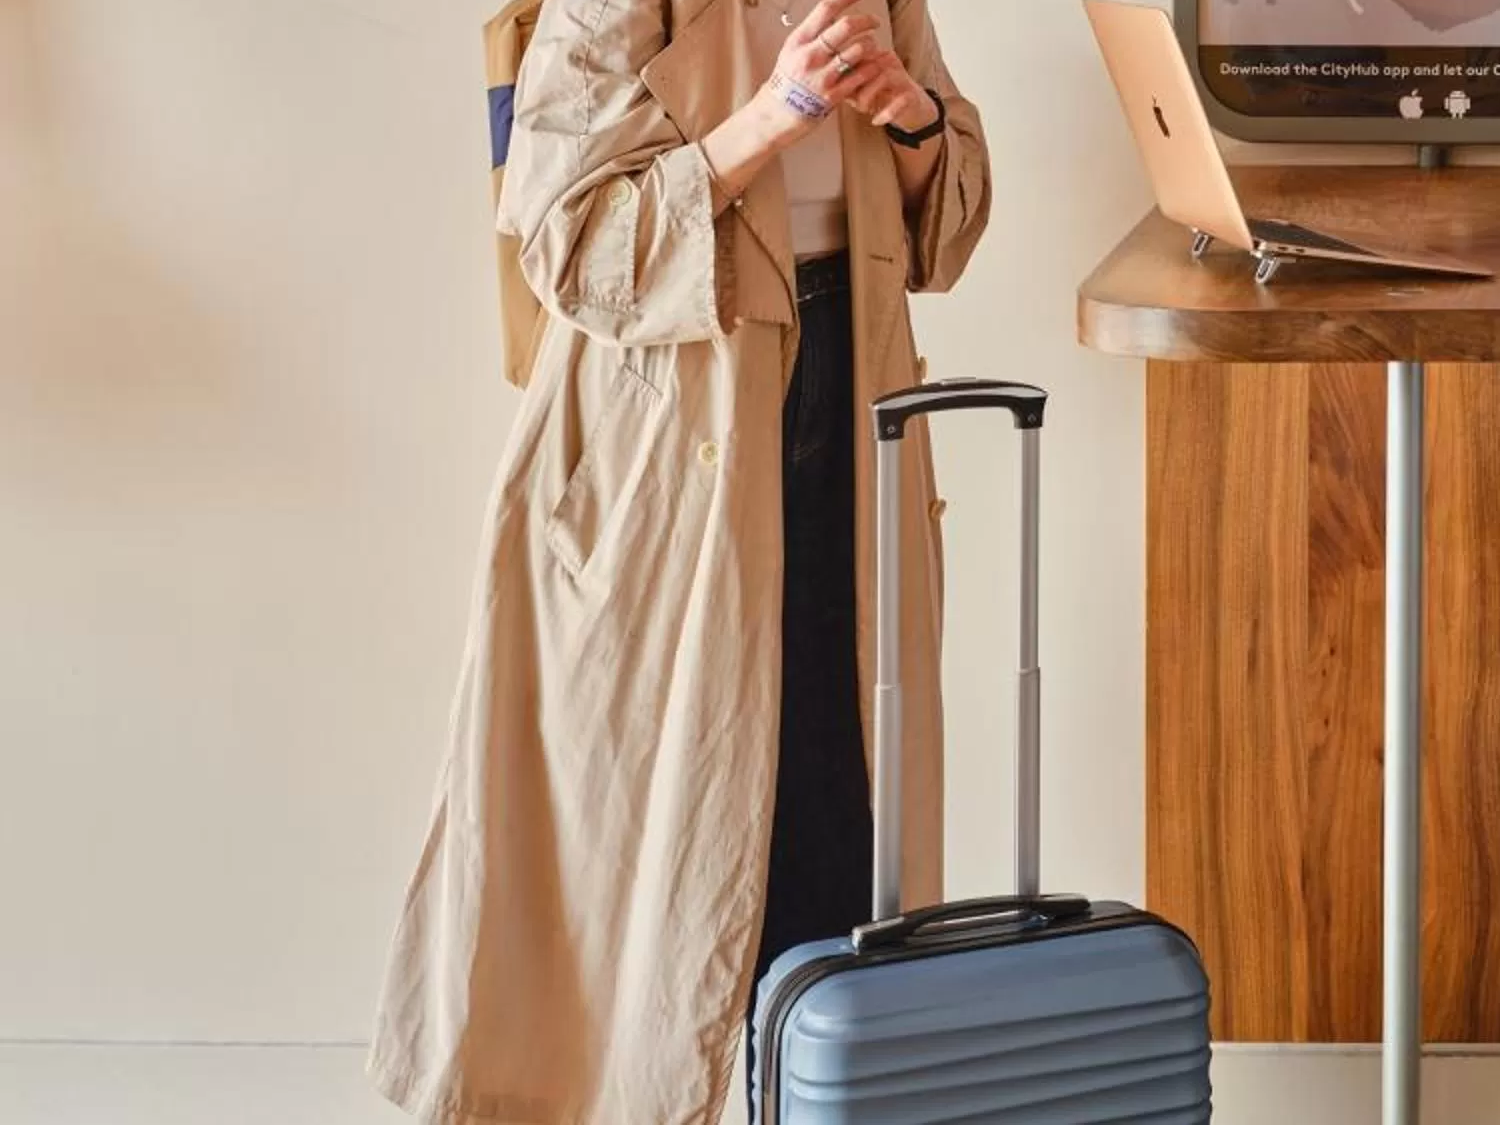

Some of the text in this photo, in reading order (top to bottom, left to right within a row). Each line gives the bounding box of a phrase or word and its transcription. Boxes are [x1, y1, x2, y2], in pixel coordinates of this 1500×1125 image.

[1219, 62, 1290, 76] Download
[1293, 62, 1318, 76] the
[1320, 62, 1379, 79] CityHub
[1383, 65, 1410, 79] app
[1413, 63, 1440, 76] and
[1443, 63, 1463, 76] let
[1466, 66, 1489, 76] our
